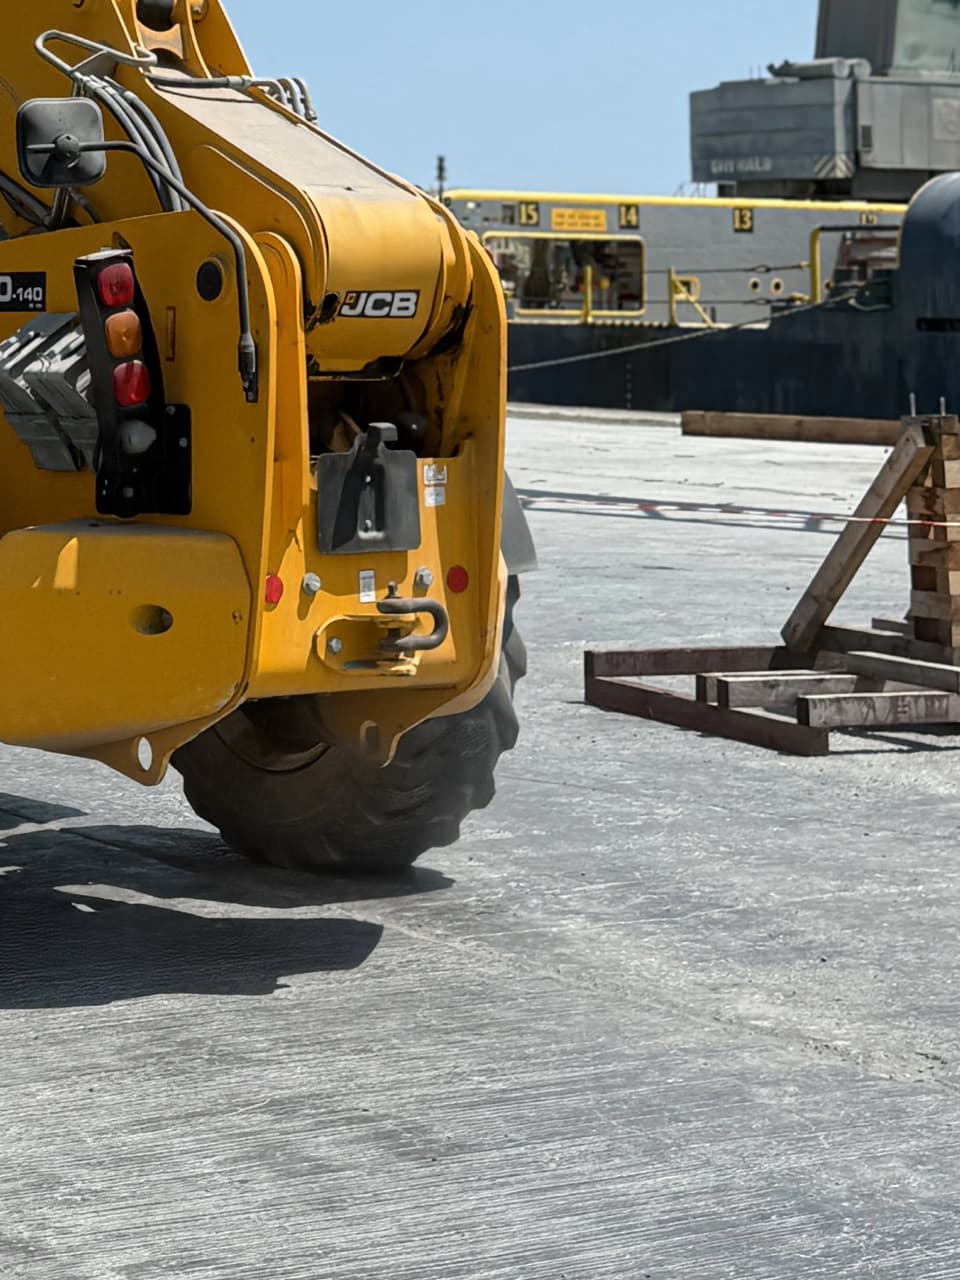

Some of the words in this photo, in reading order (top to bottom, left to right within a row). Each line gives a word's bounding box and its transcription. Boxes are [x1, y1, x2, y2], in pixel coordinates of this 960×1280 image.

[520, 203, 539, 225] 15
[619, 206, 638, 227] 14
[734, 208, 753, 231] 13
[341, 292, 418, 317] JCB
